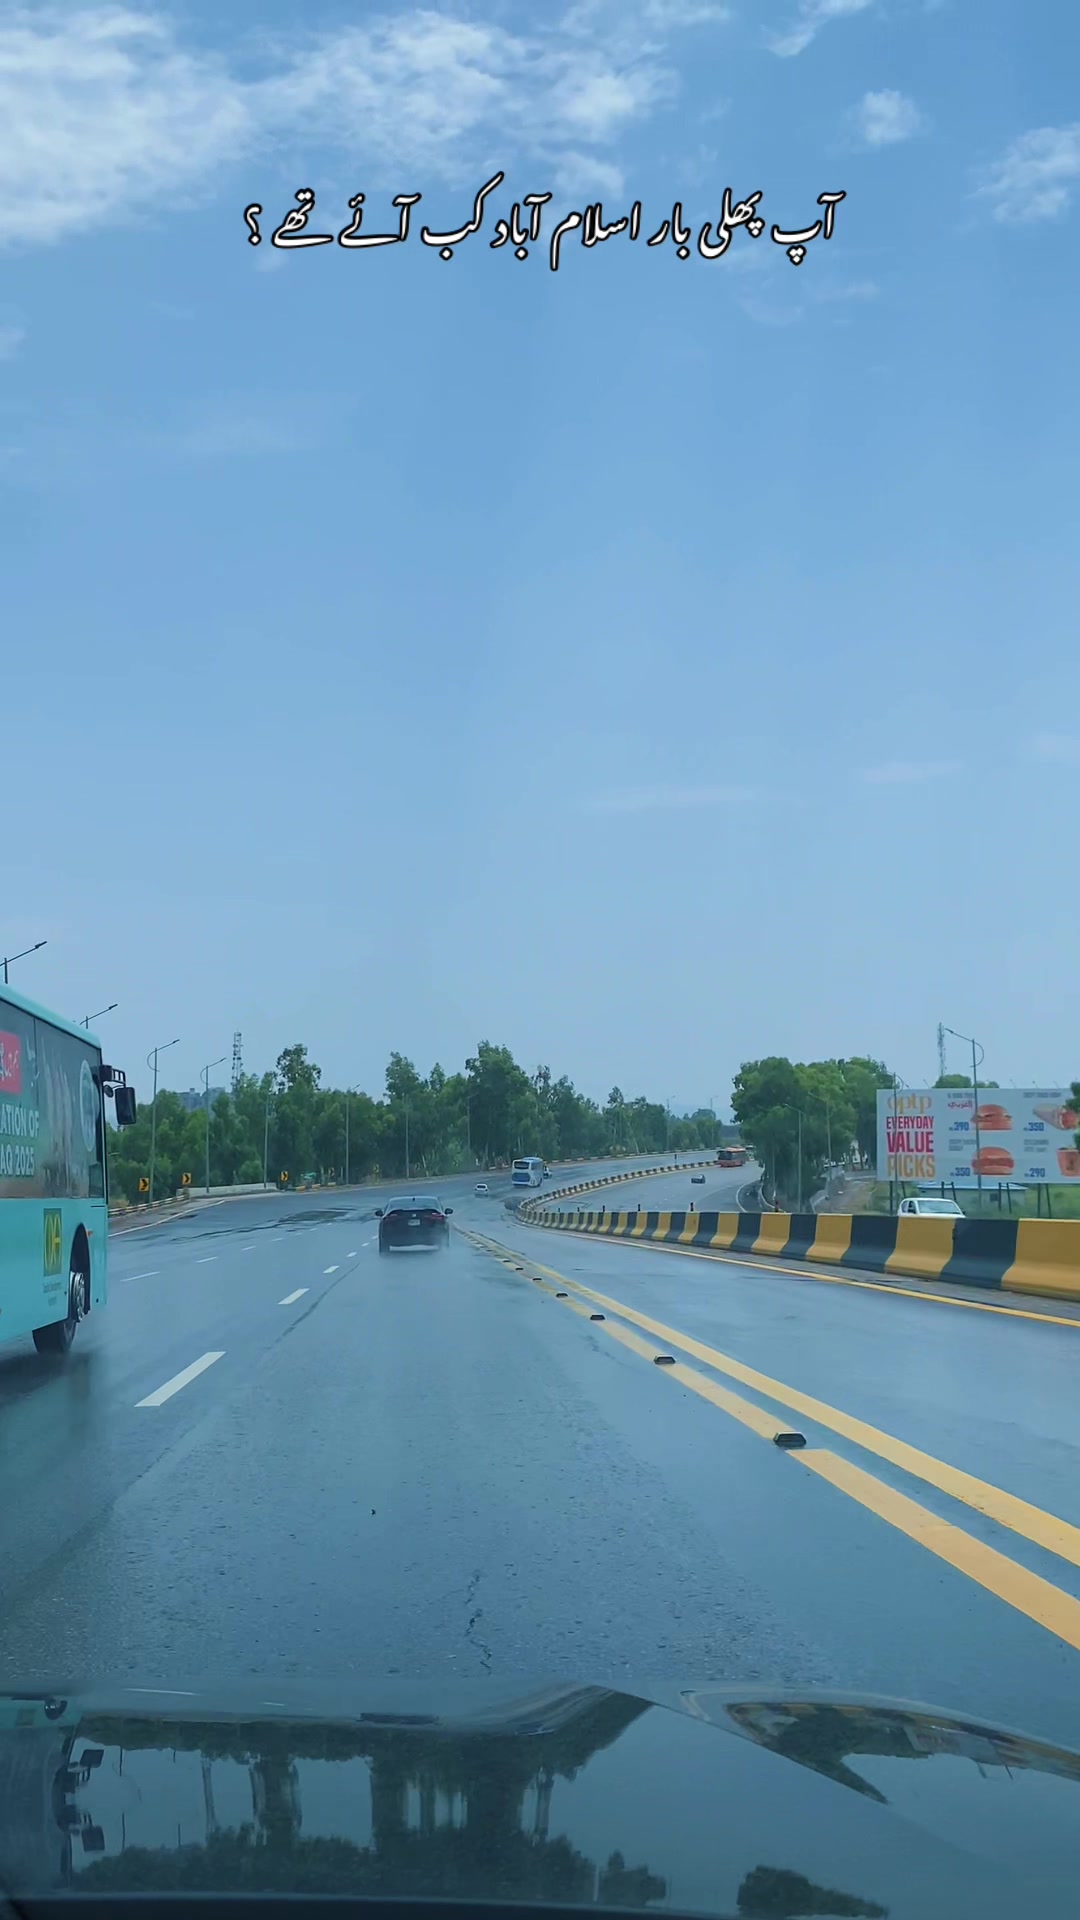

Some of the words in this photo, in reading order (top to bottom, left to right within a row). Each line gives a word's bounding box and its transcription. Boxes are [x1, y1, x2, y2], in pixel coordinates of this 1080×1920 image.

[28, 1109, 40, 1138] OF
[886, 1116, 935, 1130] EVERYDAY
[886, 1131, 935, 1153] VALUE
[15, 1145, 35, 1176] 2025
[887, 1154, 937, 1178] PICKS
